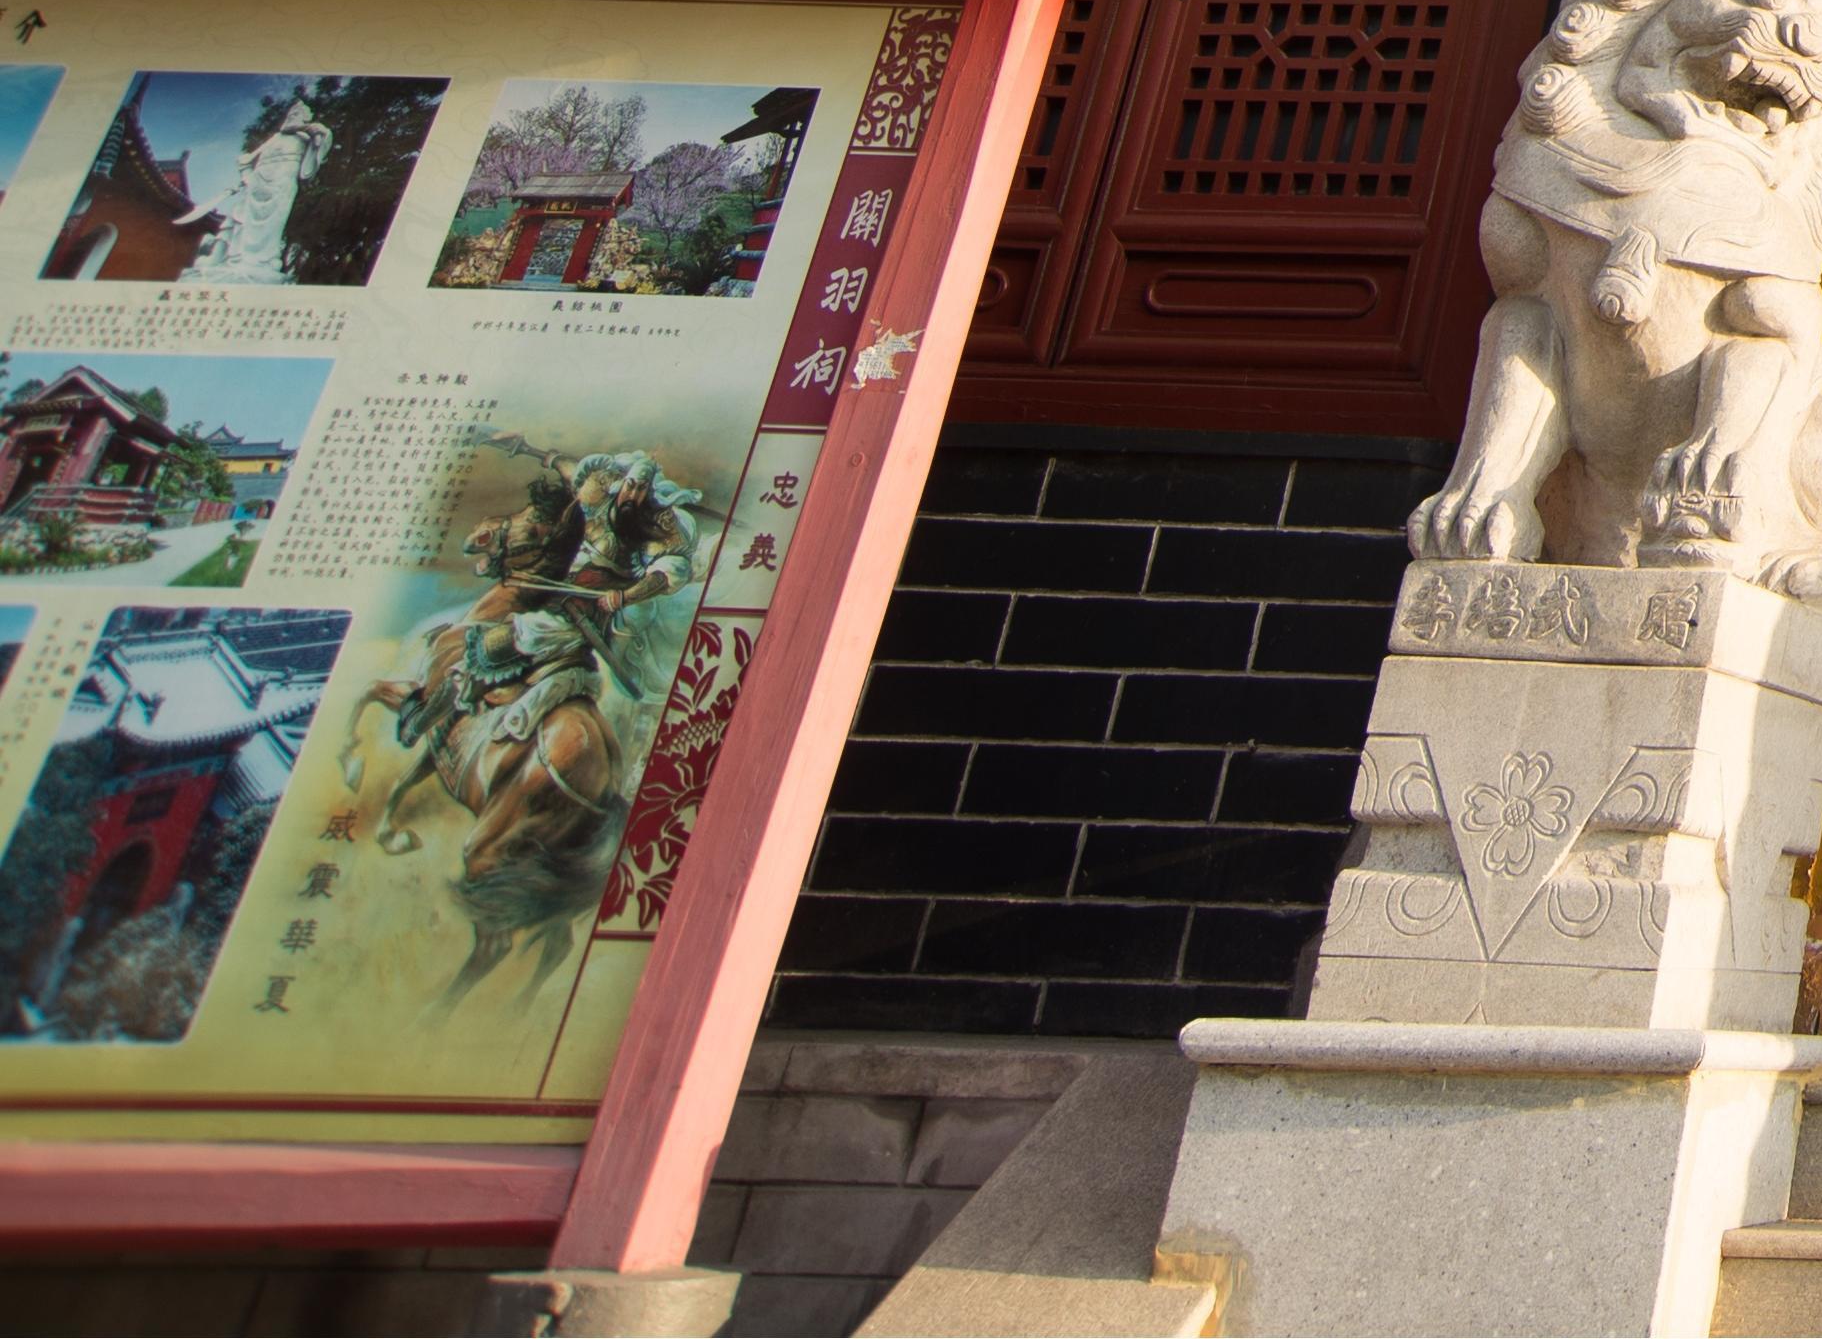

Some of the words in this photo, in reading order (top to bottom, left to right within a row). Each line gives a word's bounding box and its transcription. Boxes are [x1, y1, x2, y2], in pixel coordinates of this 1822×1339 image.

[790, 188, 894, 396] 關羽祠
[739, 471, 799, 572] 忠義
[253, 809, 359, 1013] 威震華夏
